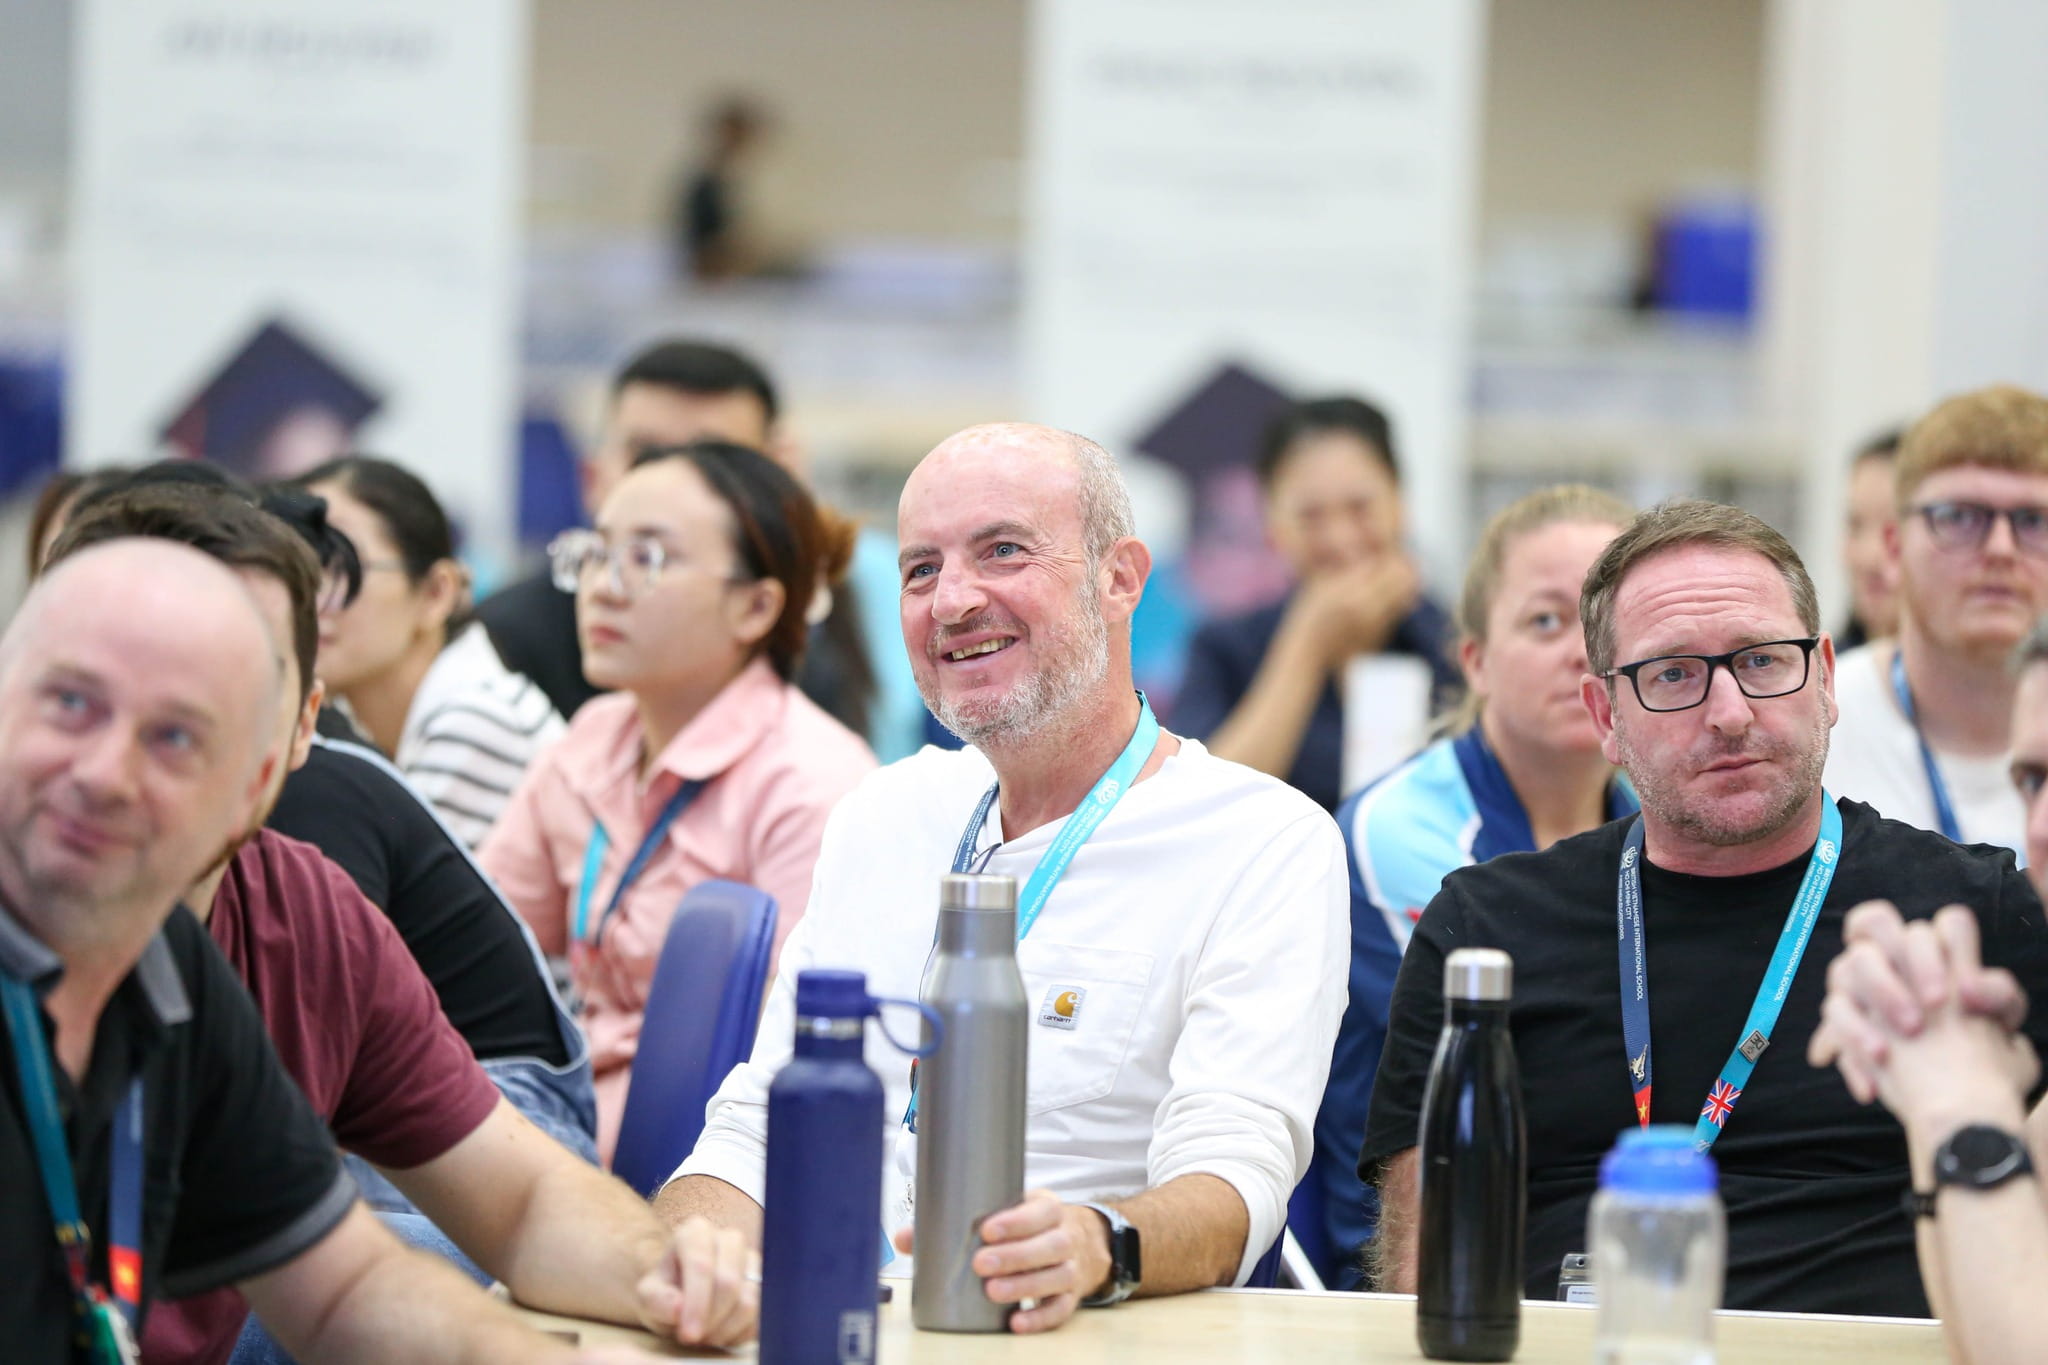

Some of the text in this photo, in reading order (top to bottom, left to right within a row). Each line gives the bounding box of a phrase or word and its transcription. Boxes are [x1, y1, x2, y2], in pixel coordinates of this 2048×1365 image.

[1625, 870, 1629, 879] HO
[1816, 864, 1824, 874] HO
[1804, 885, 1816, 902] MINH
[1799, 902, 1809, 917] CITY
[1773, 867, 1831, 1001] BRITISH VIETNAMESE INTERNATIONAL SCHOOL
[1633, 928, 1641, 974] INTERNATIONAL
